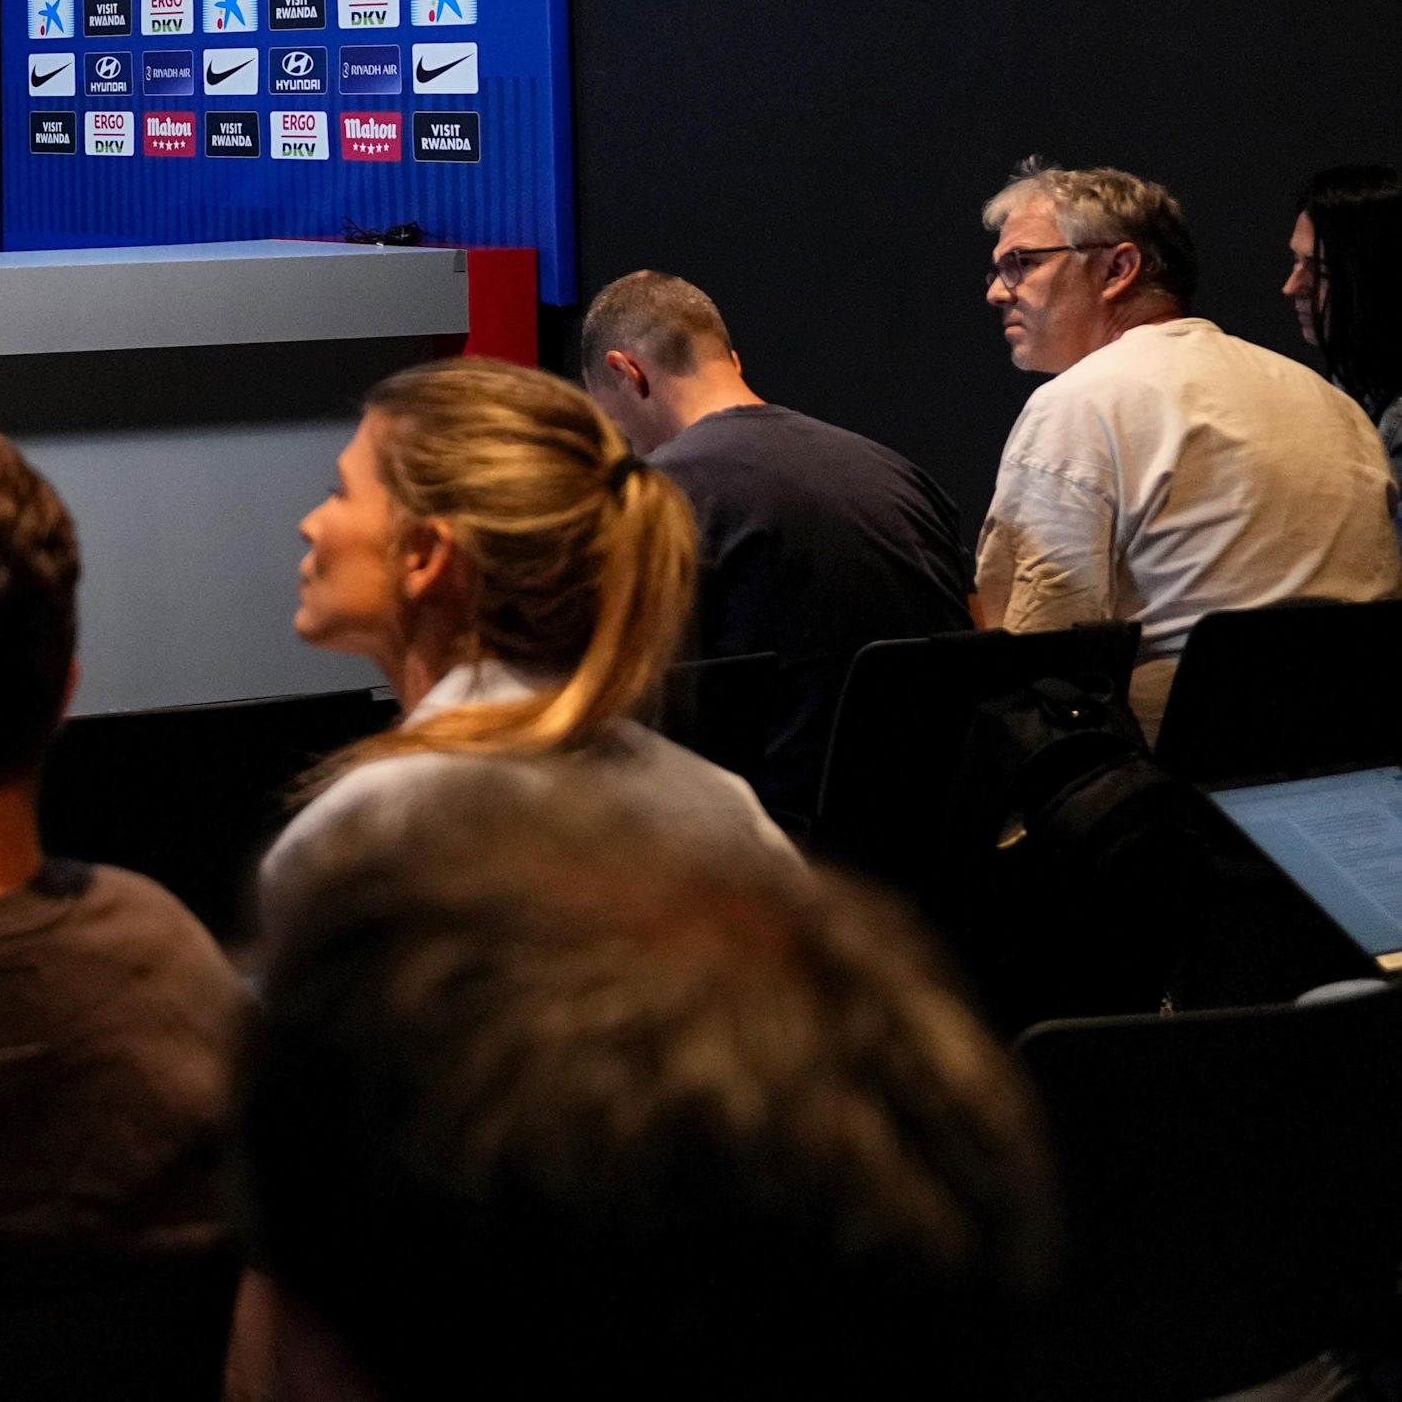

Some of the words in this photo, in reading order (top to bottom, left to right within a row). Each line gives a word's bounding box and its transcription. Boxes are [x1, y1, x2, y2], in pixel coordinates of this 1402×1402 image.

[96, 2, 118, 15] VISIT
[89, 14, 126, 27] RWANDA
[350, 10, 387, 26] DKV
[351, 64, 382, 76] RIYADH
[382, 64, 398, 75] AIR
[276, 79, 321, 91] HYUNDAI
[42, 121, 63, 133] VISIT
[282, 114, 316, 131] ERGO
[343, 117, 397, 140] Mahou
[430, 124, 461, 137] VISIT
[35, 132, 70, 144] RWANDA
[421, 137, 472, 151] RWANDA
[282, 142, 316, 157] DKV
